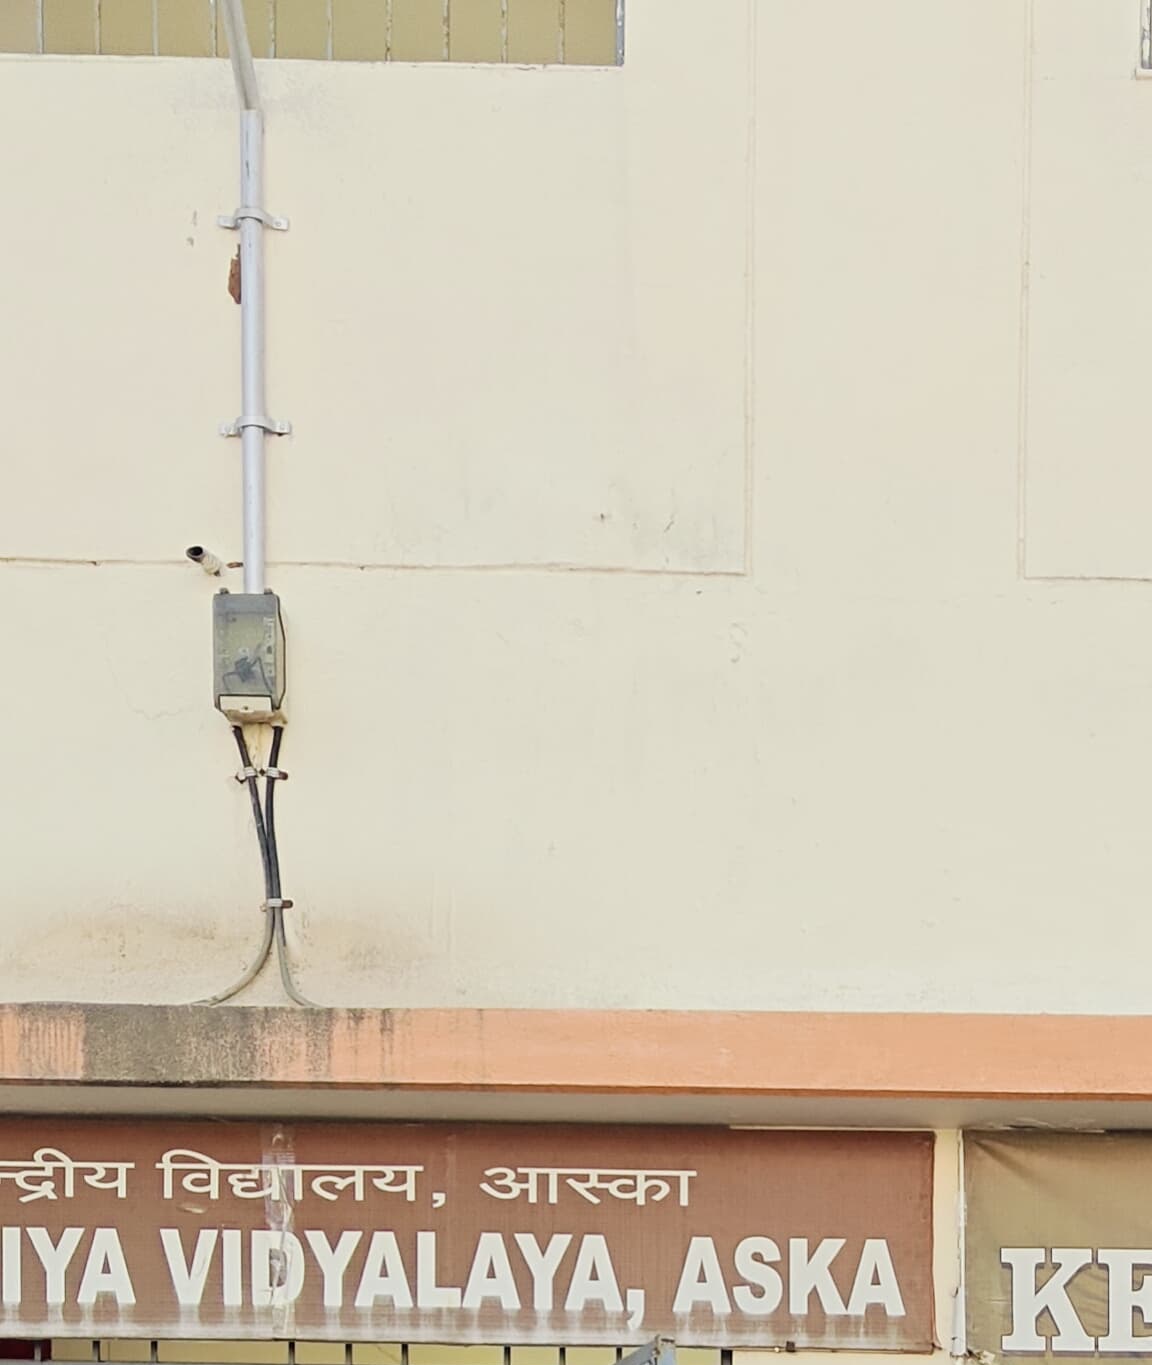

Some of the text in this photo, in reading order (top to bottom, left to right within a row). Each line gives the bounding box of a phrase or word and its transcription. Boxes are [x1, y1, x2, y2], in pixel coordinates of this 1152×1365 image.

[0, 1147, 697, 1208] न्द्रीय विद्यालय, आस्का
[2, 1227, 906, 1329] IYA VIDYALAYA, ASKA
